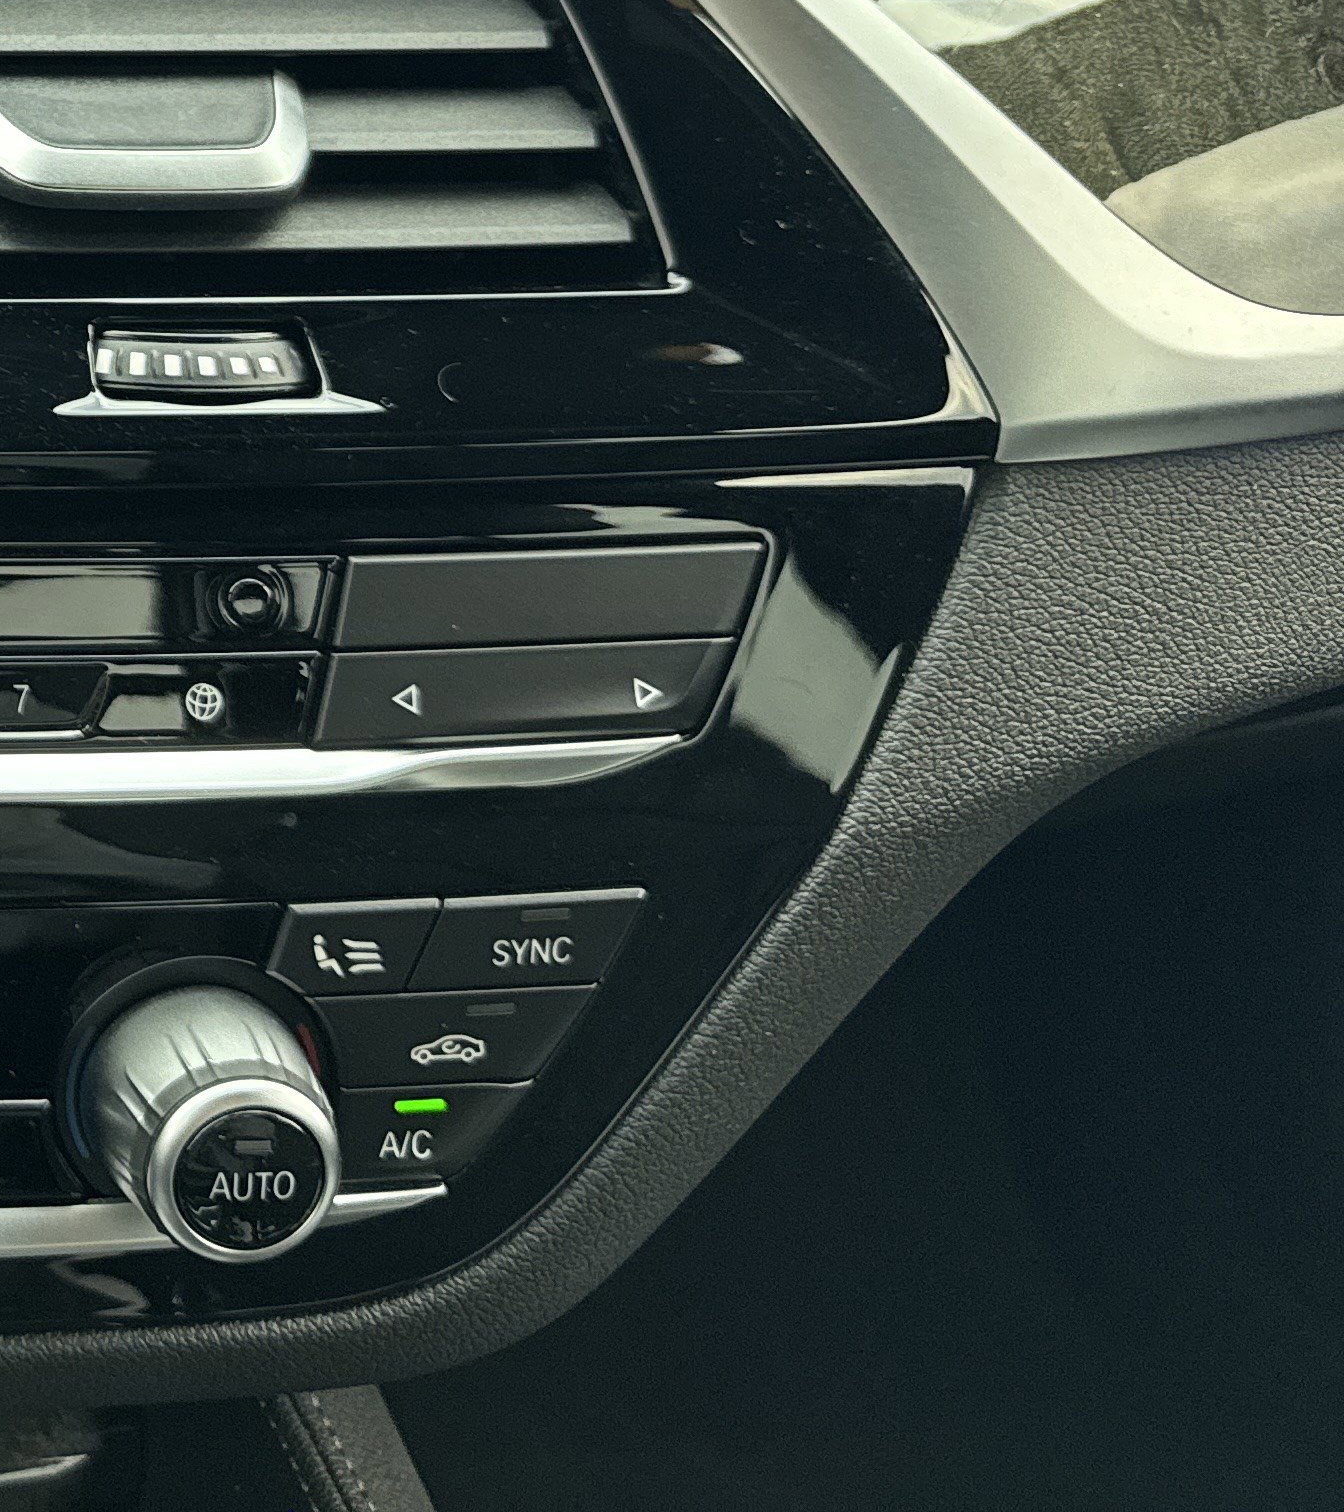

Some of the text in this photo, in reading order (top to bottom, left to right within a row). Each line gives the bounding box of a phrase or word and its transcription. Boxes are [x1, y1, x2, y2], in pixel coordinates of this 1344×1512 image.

[12, 685, 31, 715] 7
[492, 937, 574, 967] SYNC
[379, 1130, 433, 1159] A/C
[210, 1171, 296, 1201] AUTO
